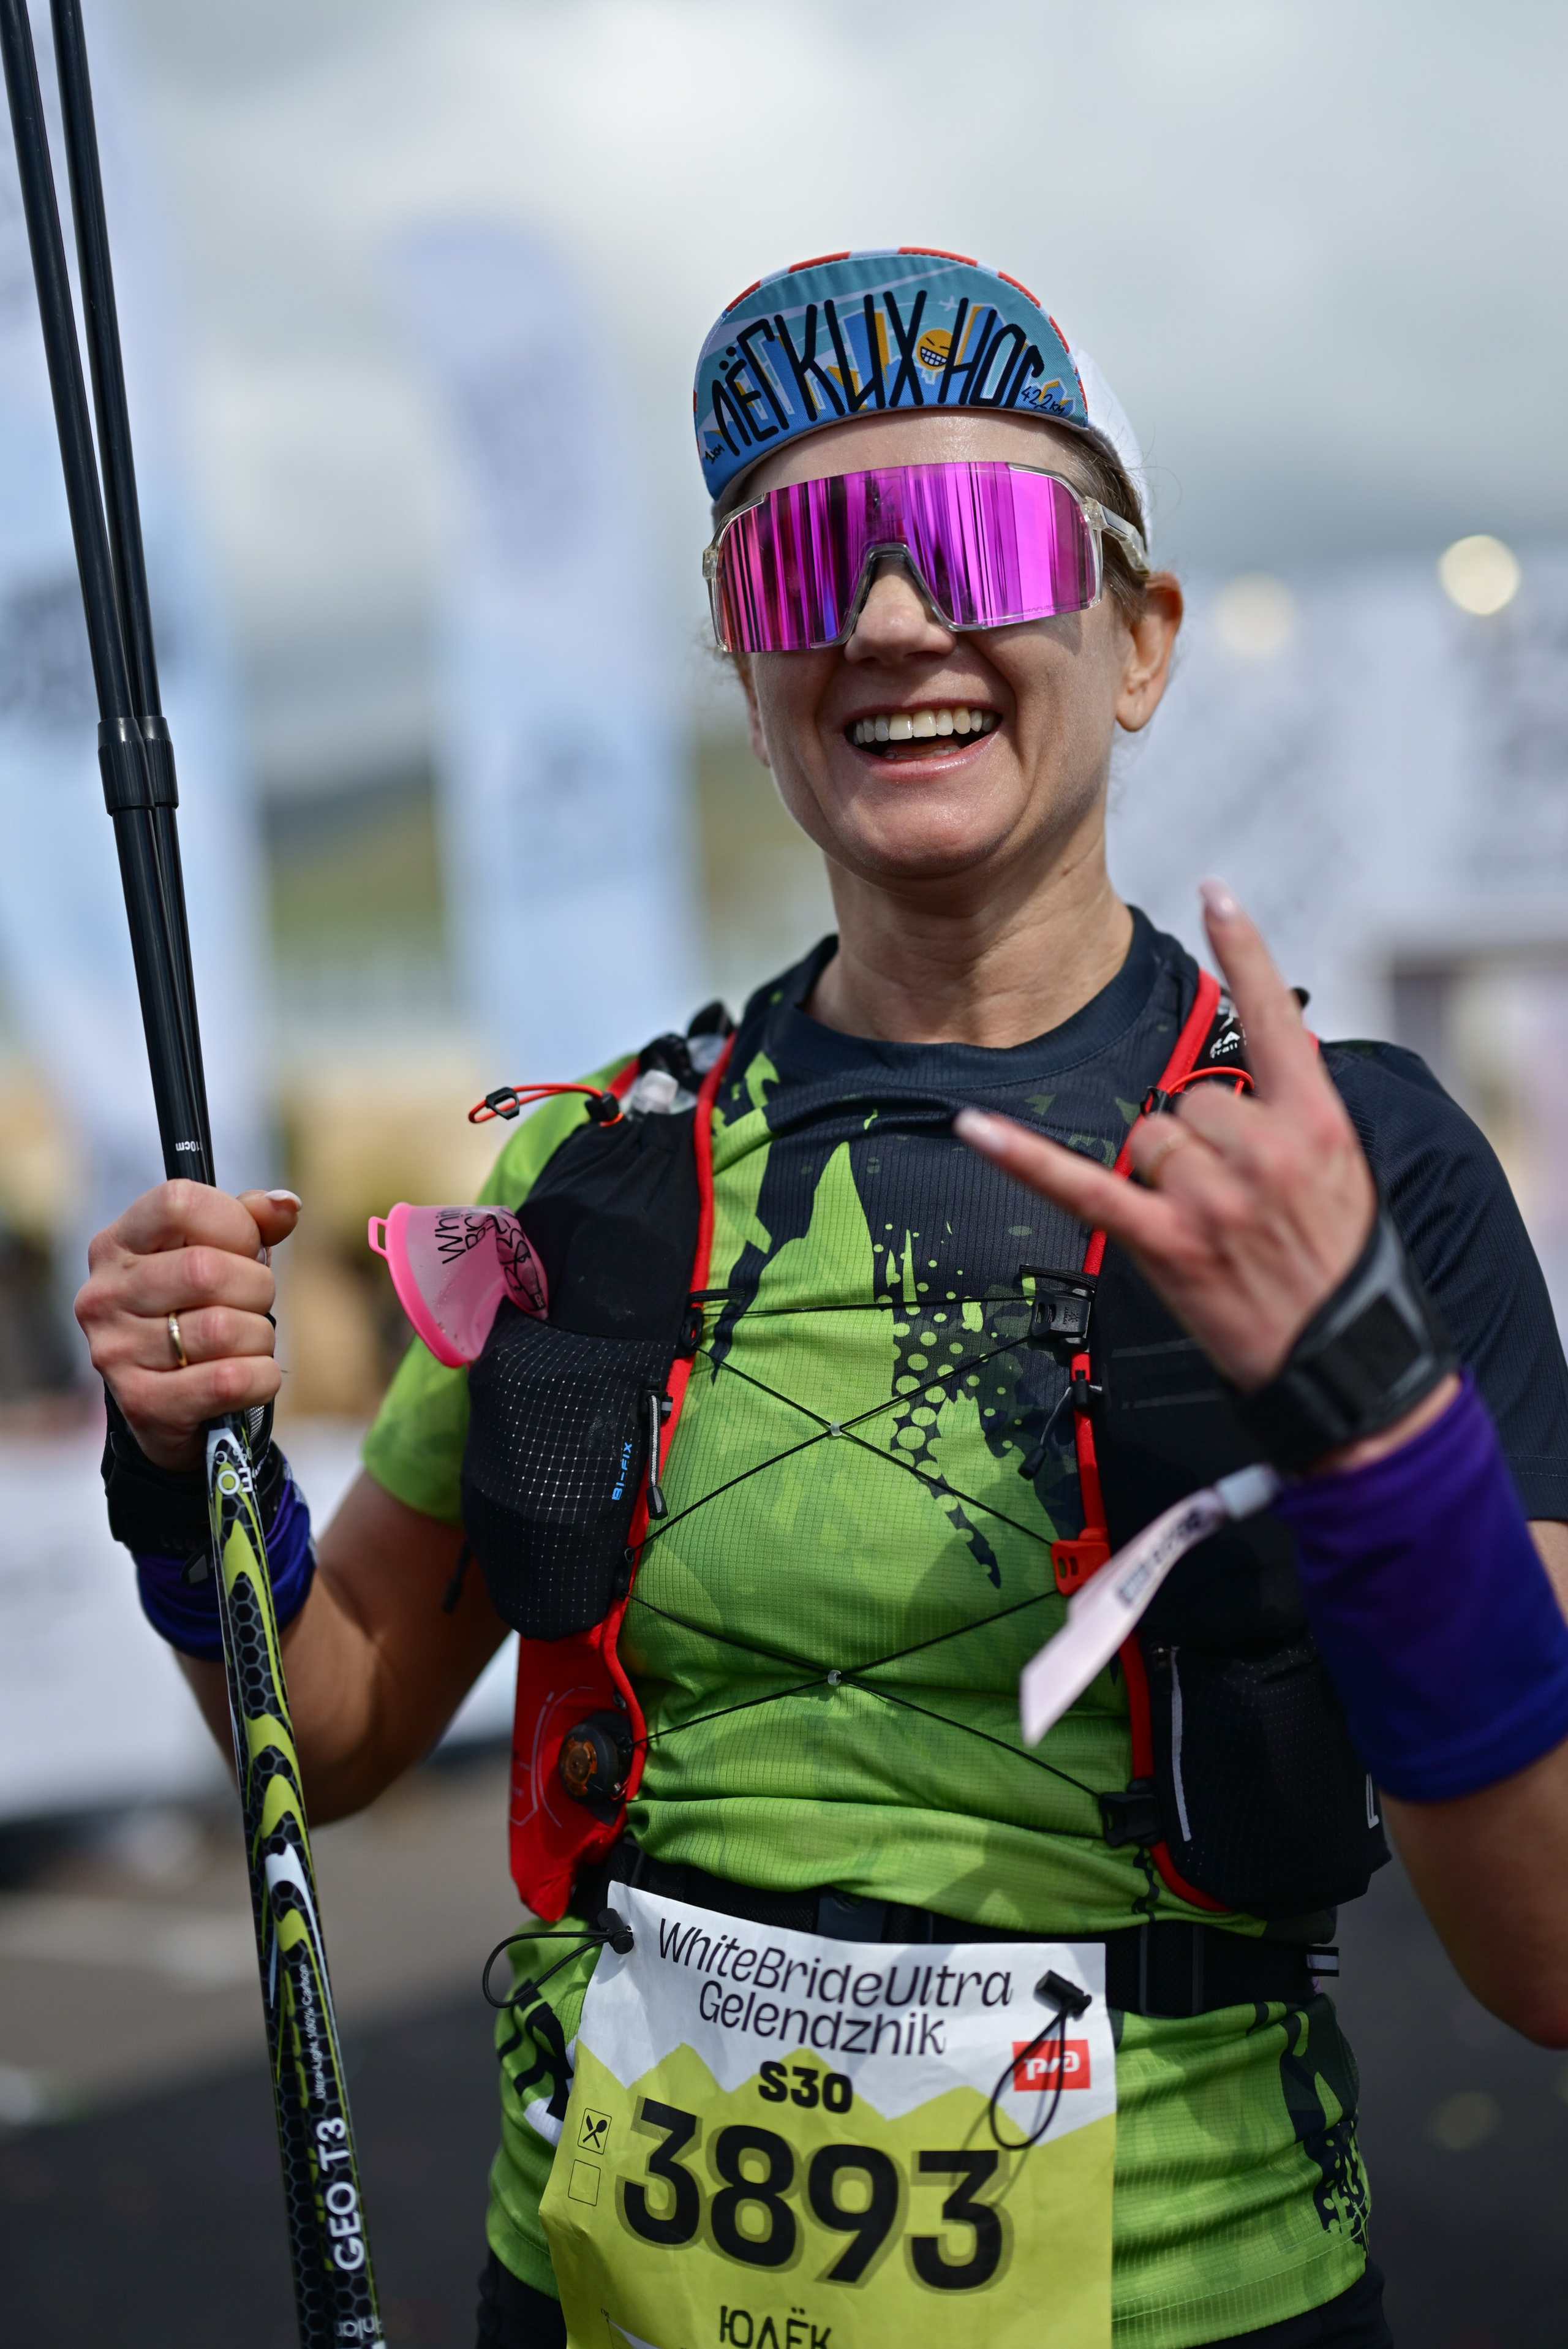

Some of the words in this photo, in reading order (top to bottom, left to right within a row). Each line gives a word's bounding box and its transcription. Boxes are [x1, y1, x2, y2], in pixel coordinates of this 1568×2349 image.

[611, 1442, 633, 1500] BI-FIX
[659, 1918, 1013, 2007] WhiteBrideUltra
[699, 1980, 946, 2056] Gelendzhik
[758, 2060, 853, 2114] S30
[316, 2117, 352, 2172] T3
[325, 2181, 365, 2271] GEO
[620, 2097, 1005, 2293] 3893
